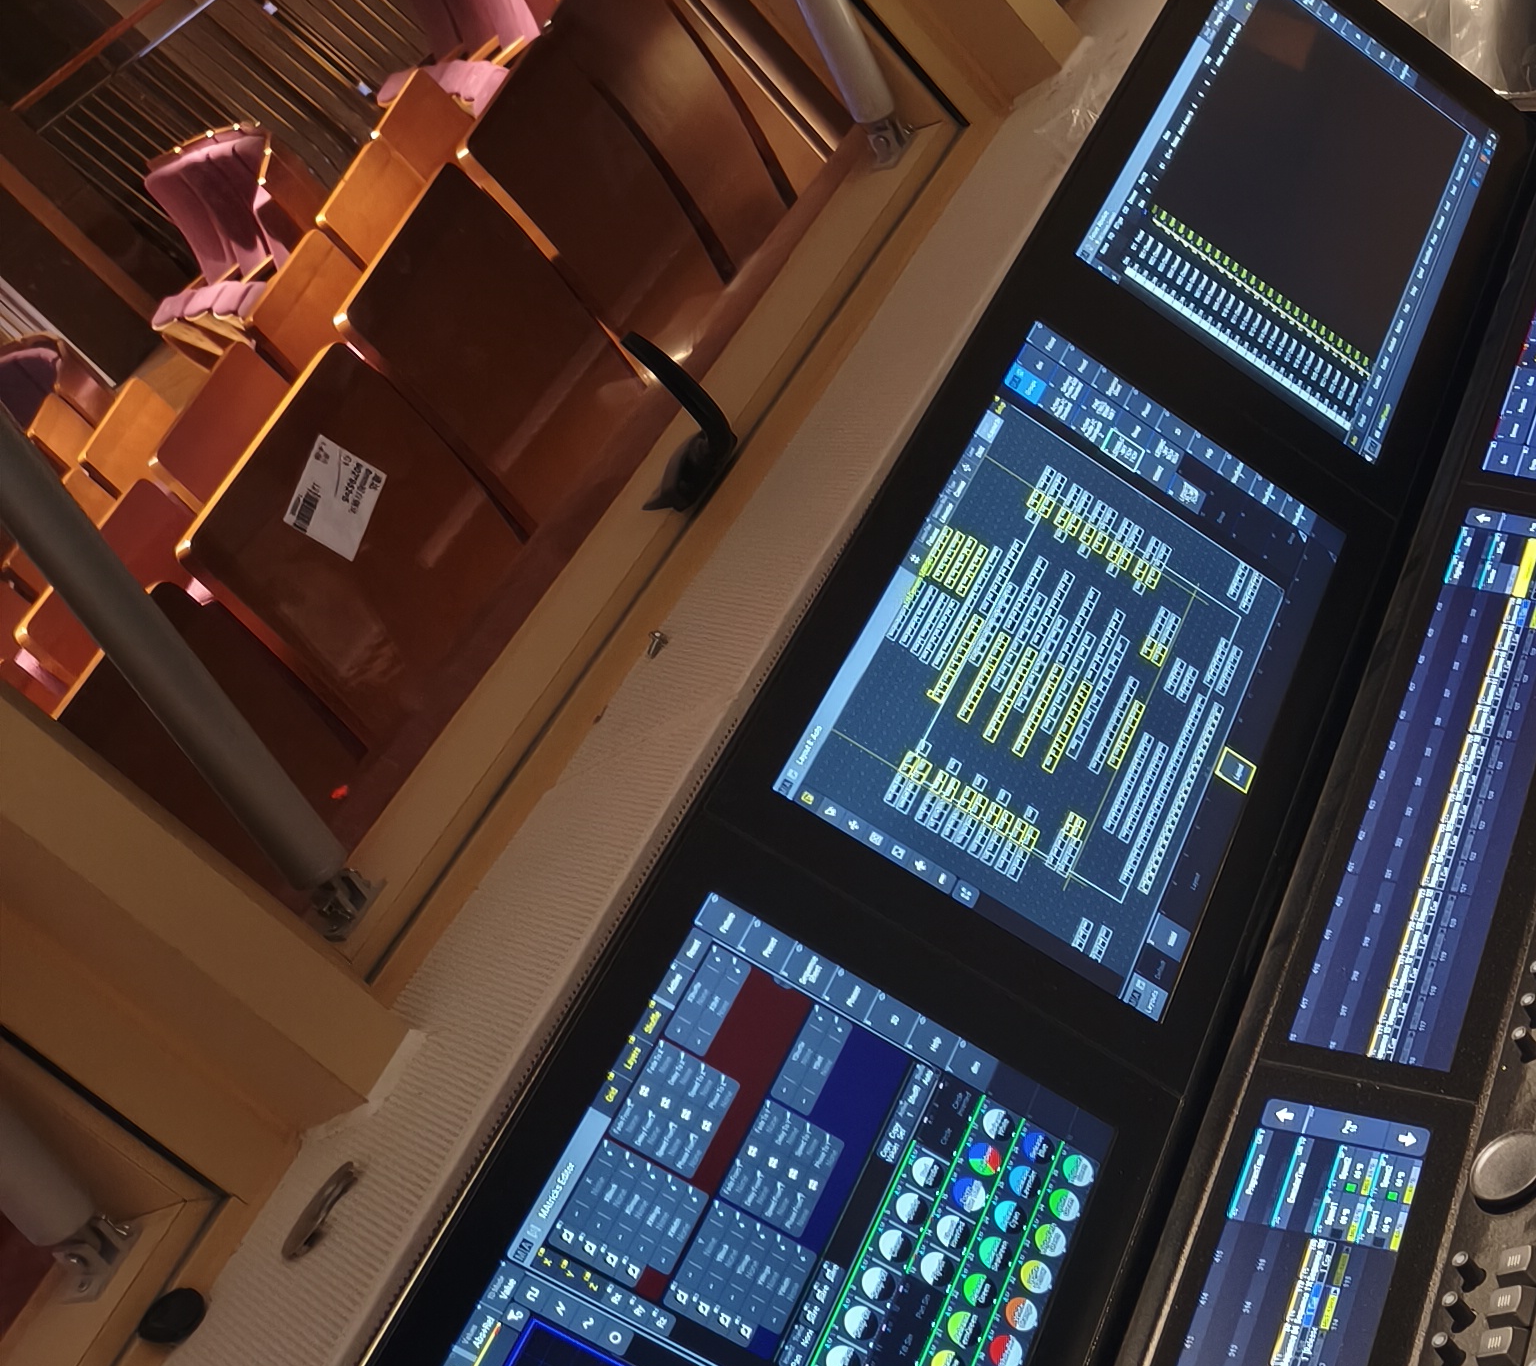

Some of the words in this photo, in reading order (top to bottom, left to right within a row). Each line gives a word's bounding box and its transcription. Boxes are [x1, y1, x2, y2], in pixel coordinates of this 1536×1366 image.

[622, 1044, 643, 1071] Layers
[939, 1126, 953, 1146] Circle
[1037, 1141, 1050, 1159] Blue
[536, 1182, 564, 1220] MAtricks
[555, 1159, 576, 1186] Editor
[1008, 1209, 1022, 1230] Cyan
[498, 1276, 518, 1301] Value
[609, 1290, 623, 1305] Rx
[977, 1281, 992, 1304] Green
[1198, 1291, 1210, 1305] 414
[1241, 1300, 1253, 1314] 314
[470, 1314, 496, 1349] Abs+Rel
[1183, 1334, 1195, 1349] 413
